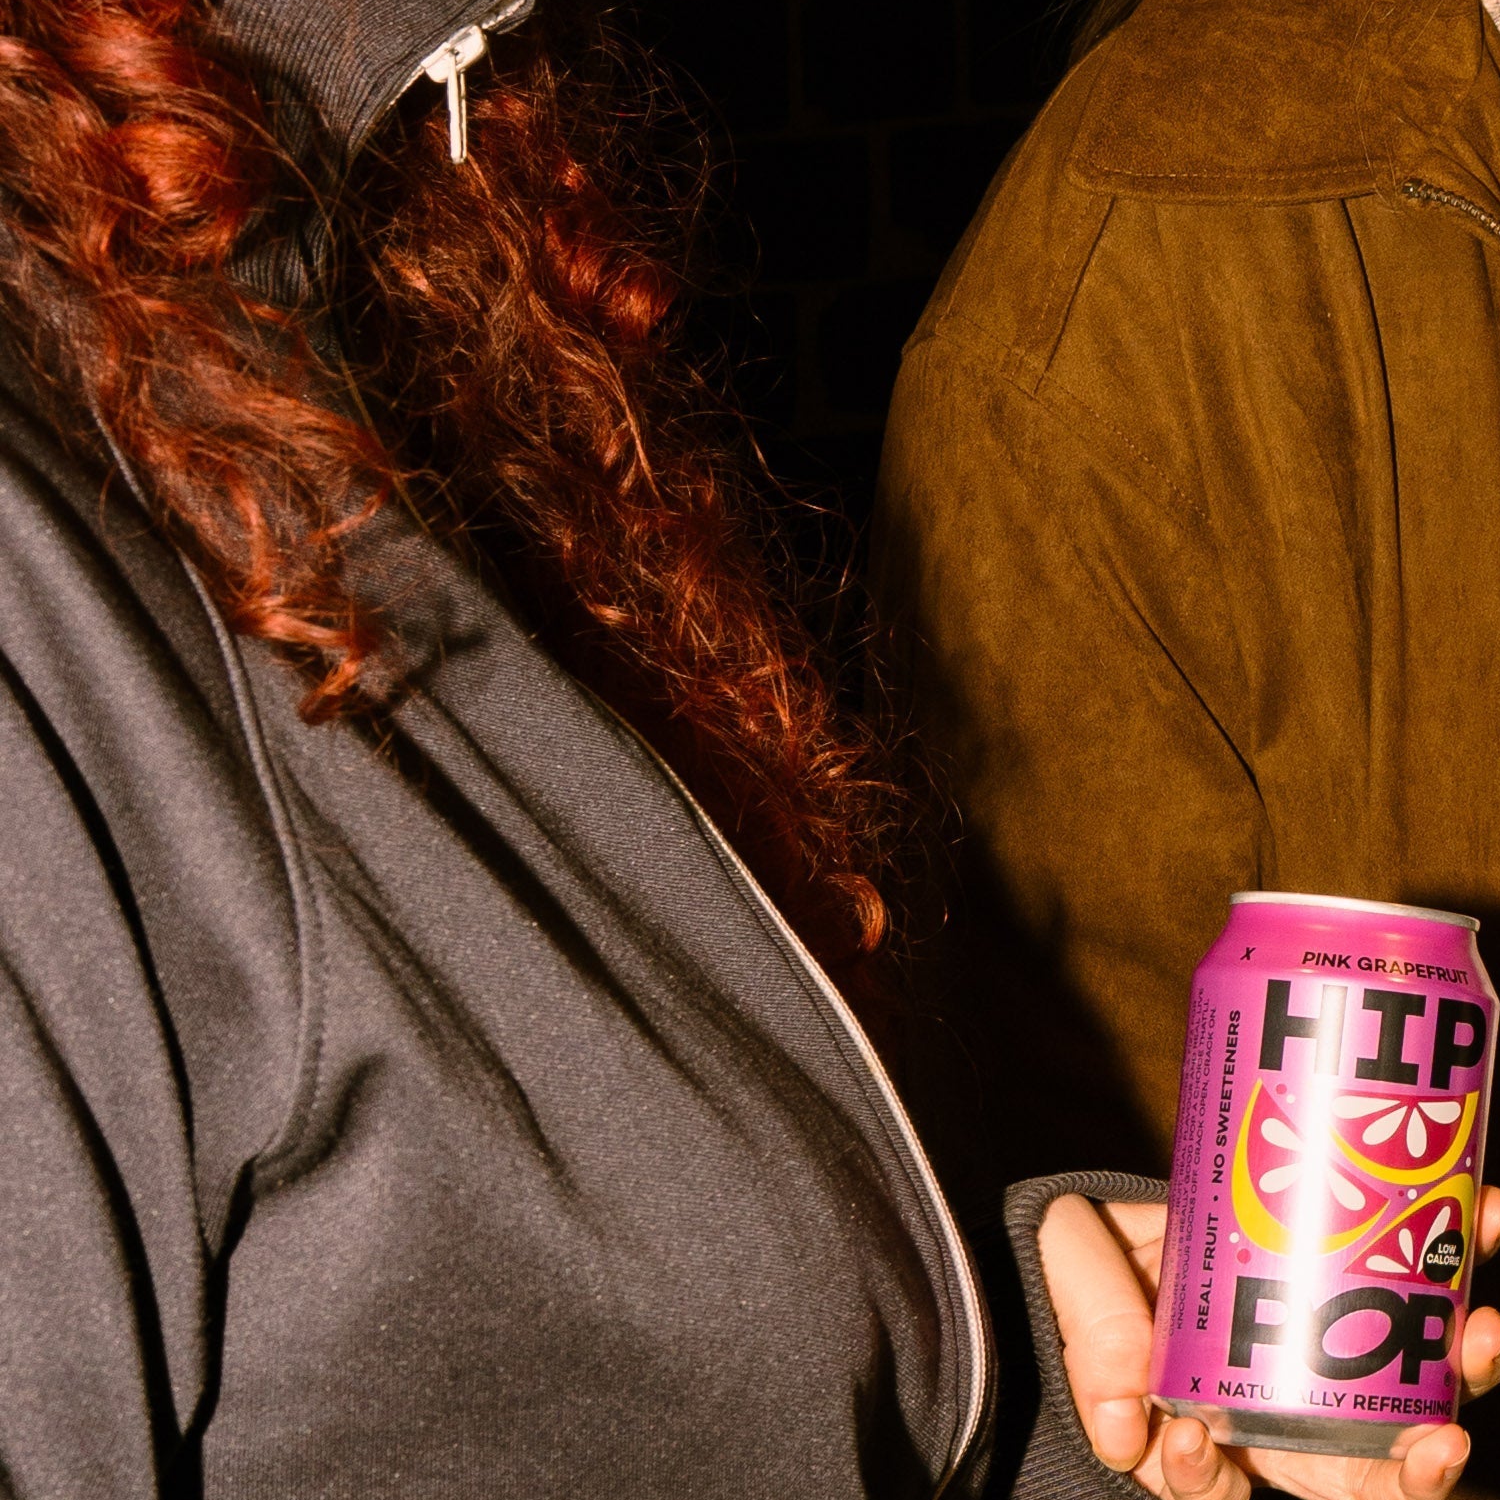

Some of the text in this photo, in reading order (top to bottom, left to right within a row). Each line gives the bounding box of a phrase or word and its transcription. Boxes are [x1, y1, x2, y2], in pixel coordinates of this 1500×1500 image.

[1302, 951, 1468, 985] PINK GRAPEFRUIT
[1258, 979, 1487, 1090] HIP
[1177, 1284, 1186, 1329] KNOCK
[1182, 1246, 1190, 1279] YOUR
[1194, 1121, 1203, 1164] CRACK
[1203, 1032, 1213, 1076] CRACK
[1196, 1010, 1240, 1330] REAL FRUIT NO SWEETENERS
[1438, 1243, 1457, 1254] LOW
[1228, 1275, 1456, 1385] POP
[1217, 1380, 1347, 1408] NATULLY
[1352, 1394, 1451, 1417] REFRESHING
